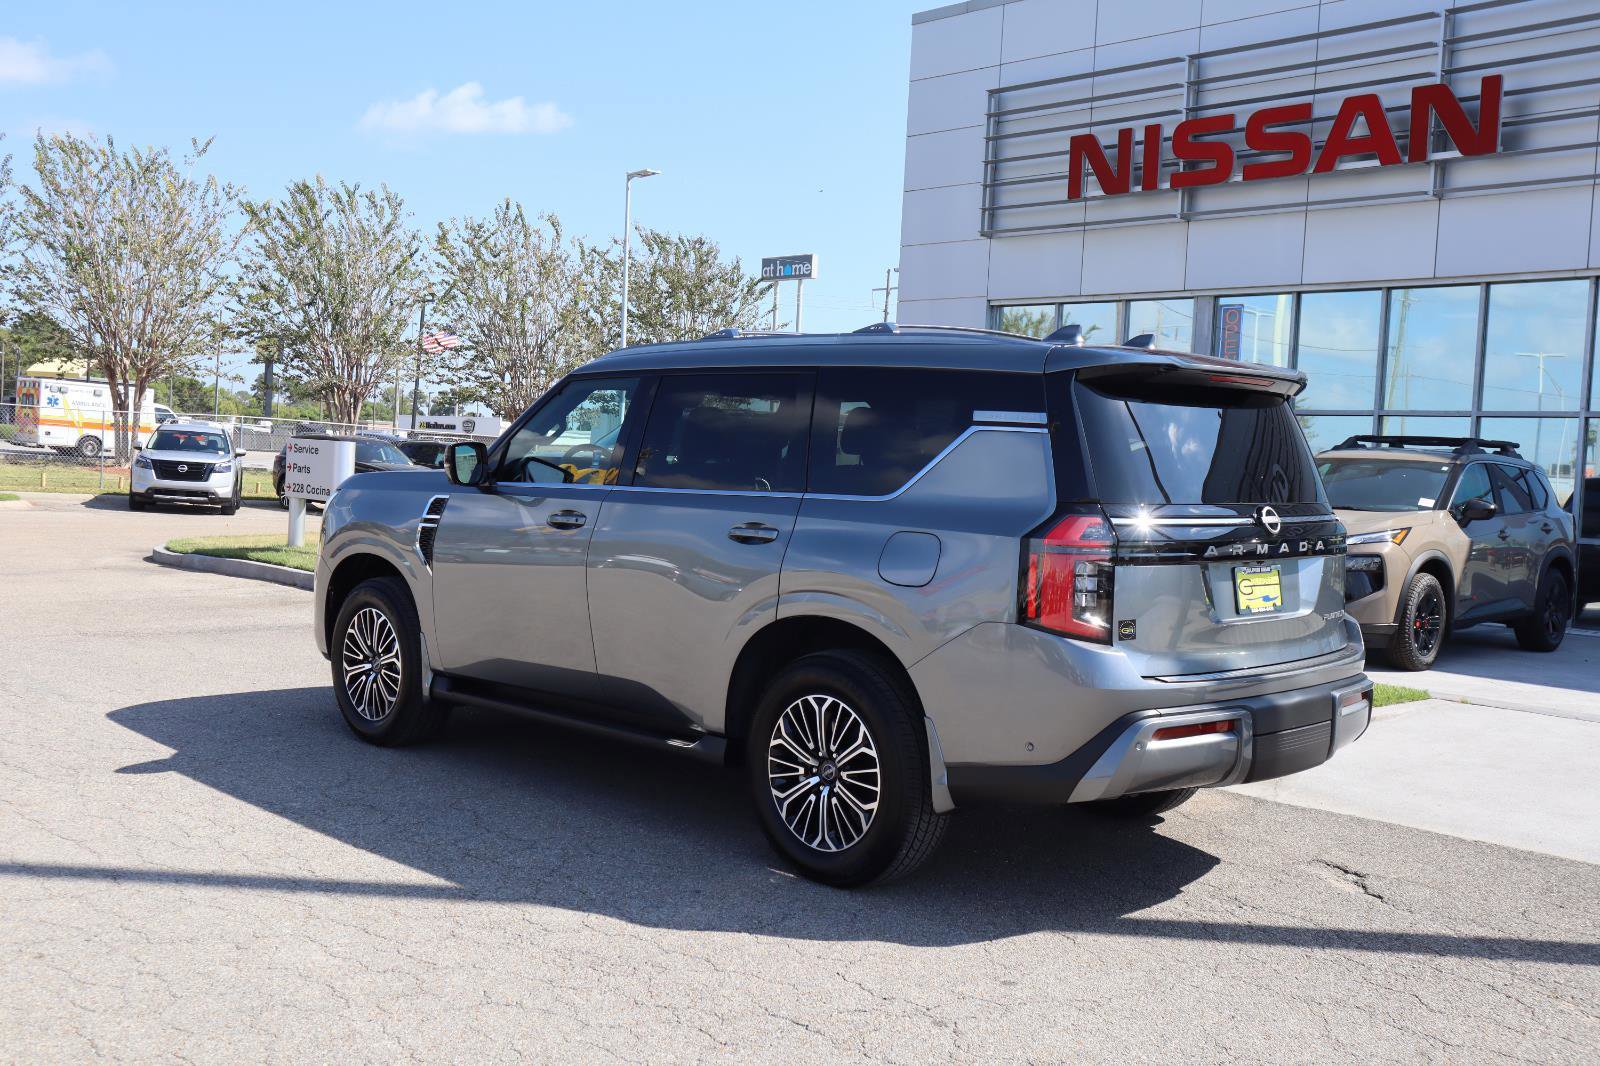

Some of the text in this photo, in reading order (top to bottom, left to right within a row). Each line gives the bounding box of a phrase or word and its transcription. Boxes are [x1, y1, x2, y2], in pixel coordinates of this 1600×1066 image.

[1067, 75, 1504, 200] NISSAN
[763, 263, 775, 277] at
[293, 443, 319, 455] Service
[292, 463, 311, 474] Parts
[292, 483, 331, 496] 228 Cocina
[1203, 540, 1325, 558] ARMADA
